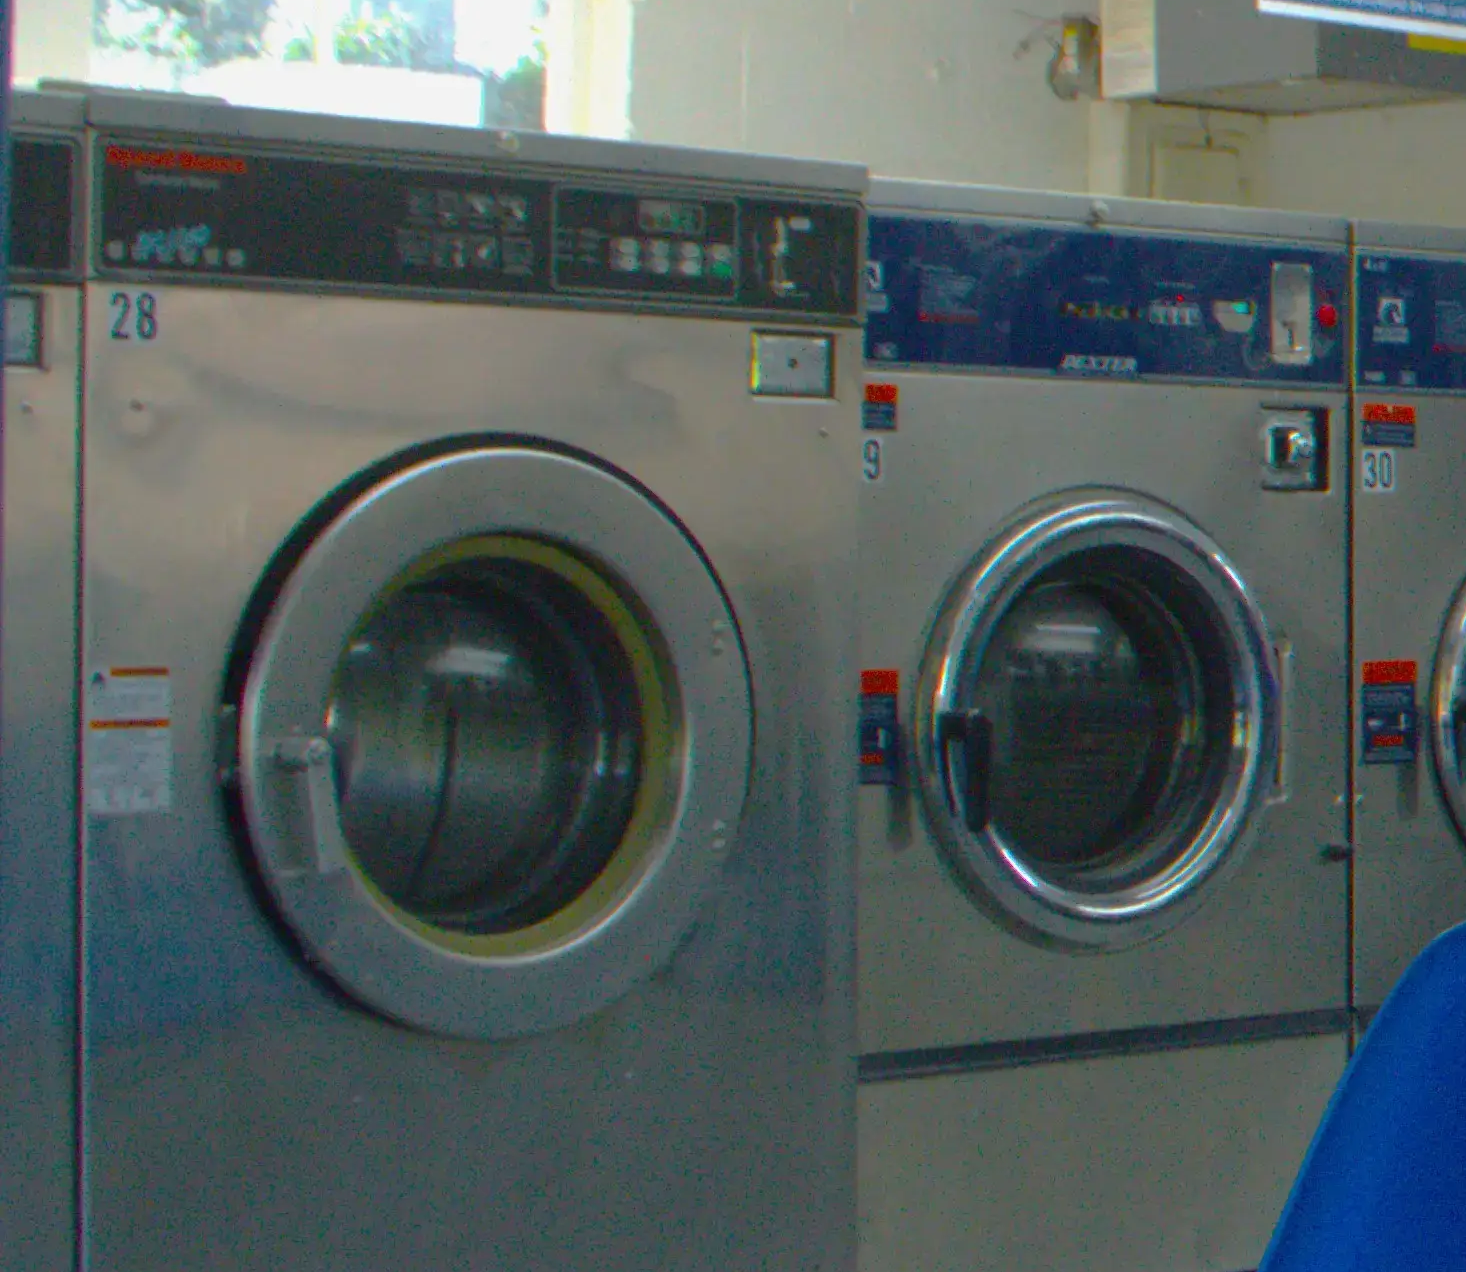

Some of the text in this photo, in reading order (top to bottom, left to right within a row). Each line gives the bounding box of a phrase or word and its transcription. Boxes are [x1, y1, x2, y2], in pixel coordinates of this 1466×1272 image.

[111, 291, 158, 341] 28
[1061, 354, 1138, 373] DEXTER
[863, 438, 881, 481] 9
[1363, 450, 1394, 491] 30
